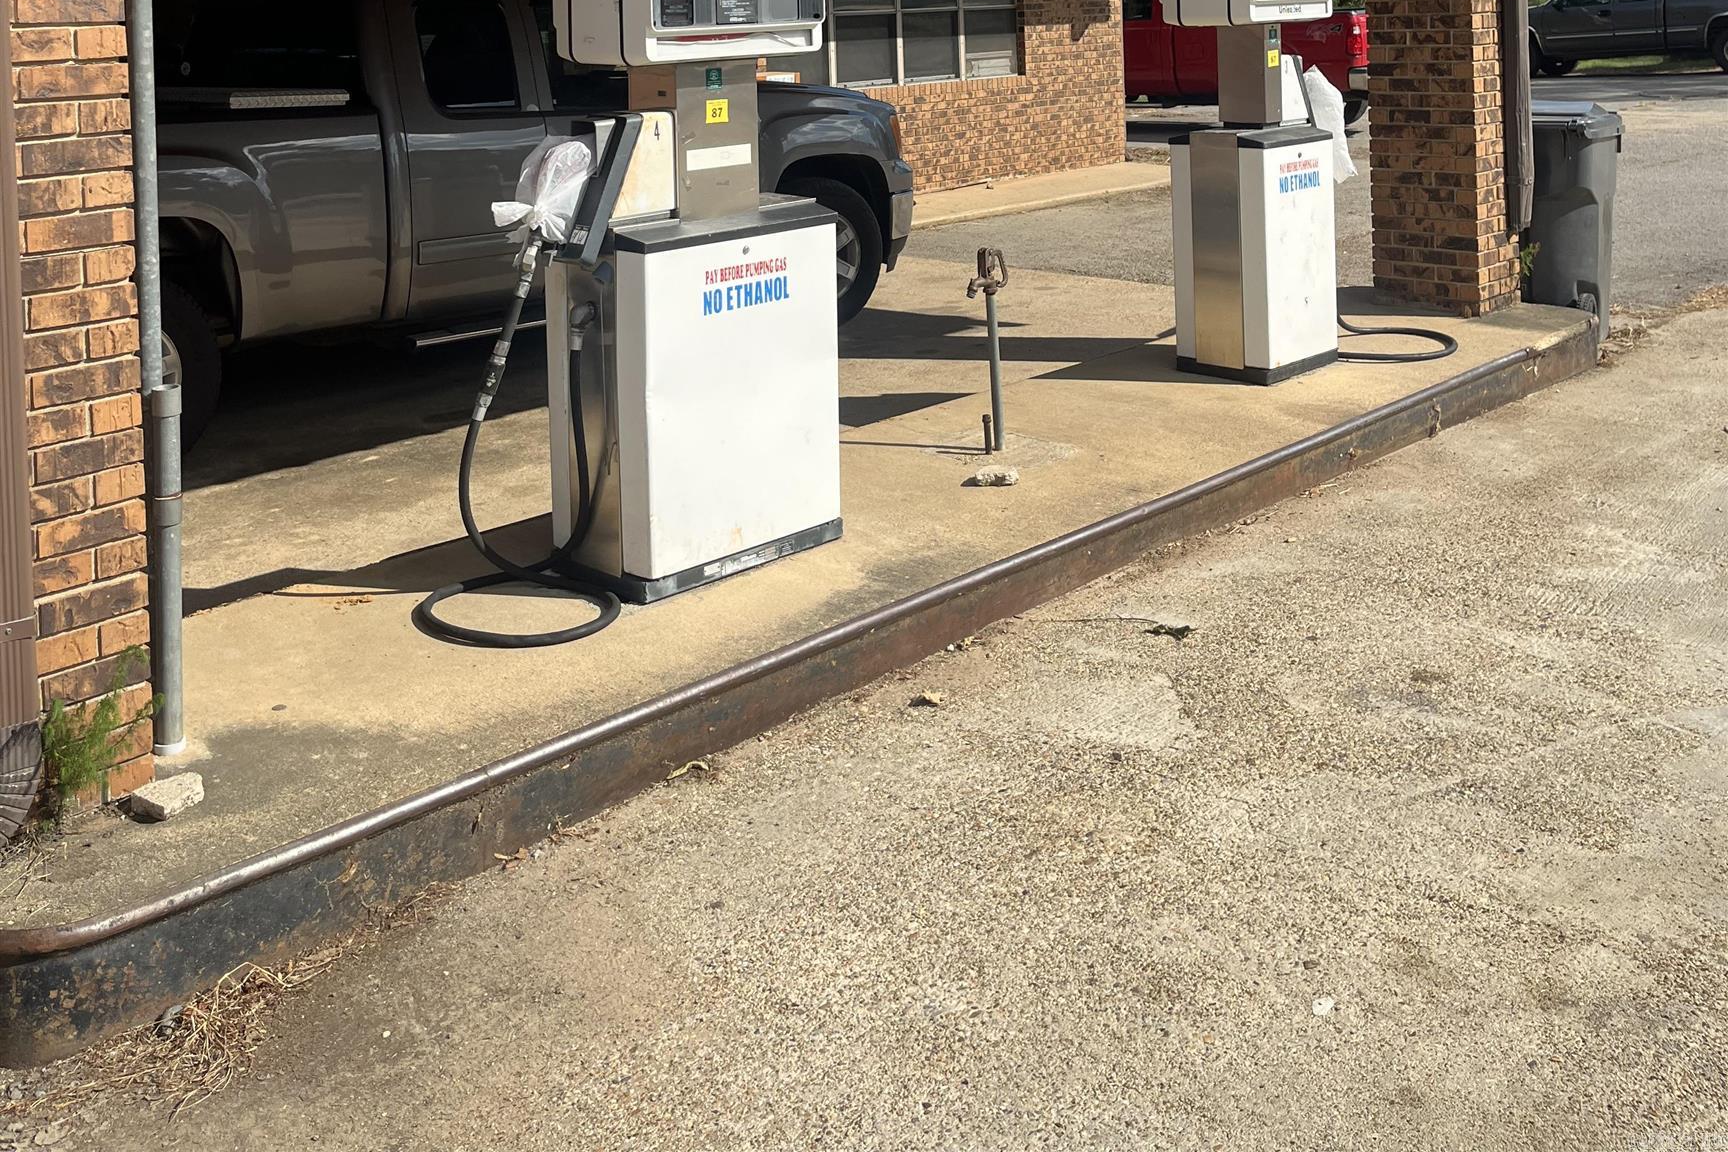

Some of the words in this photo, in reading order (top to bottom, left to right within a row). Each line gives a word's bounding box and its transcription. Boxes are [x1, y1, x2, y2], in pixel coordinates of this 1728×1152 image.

[711, 107, 723, 119] 87
[654, 120, 660, 141] 4
[1279, 176, 1289, 193] NO
[1290, 170, 1320, 191] ETHANOL
[705, 269, 718, 285] PAY
[720, 264, 744, 283] BEFORE
[745, 259, 774, 277] PUMPING
[775, 256, 787, 272] GAS
[703, 288, 723, 316] NO
[726, 275, 790, 311] ETHANOL
